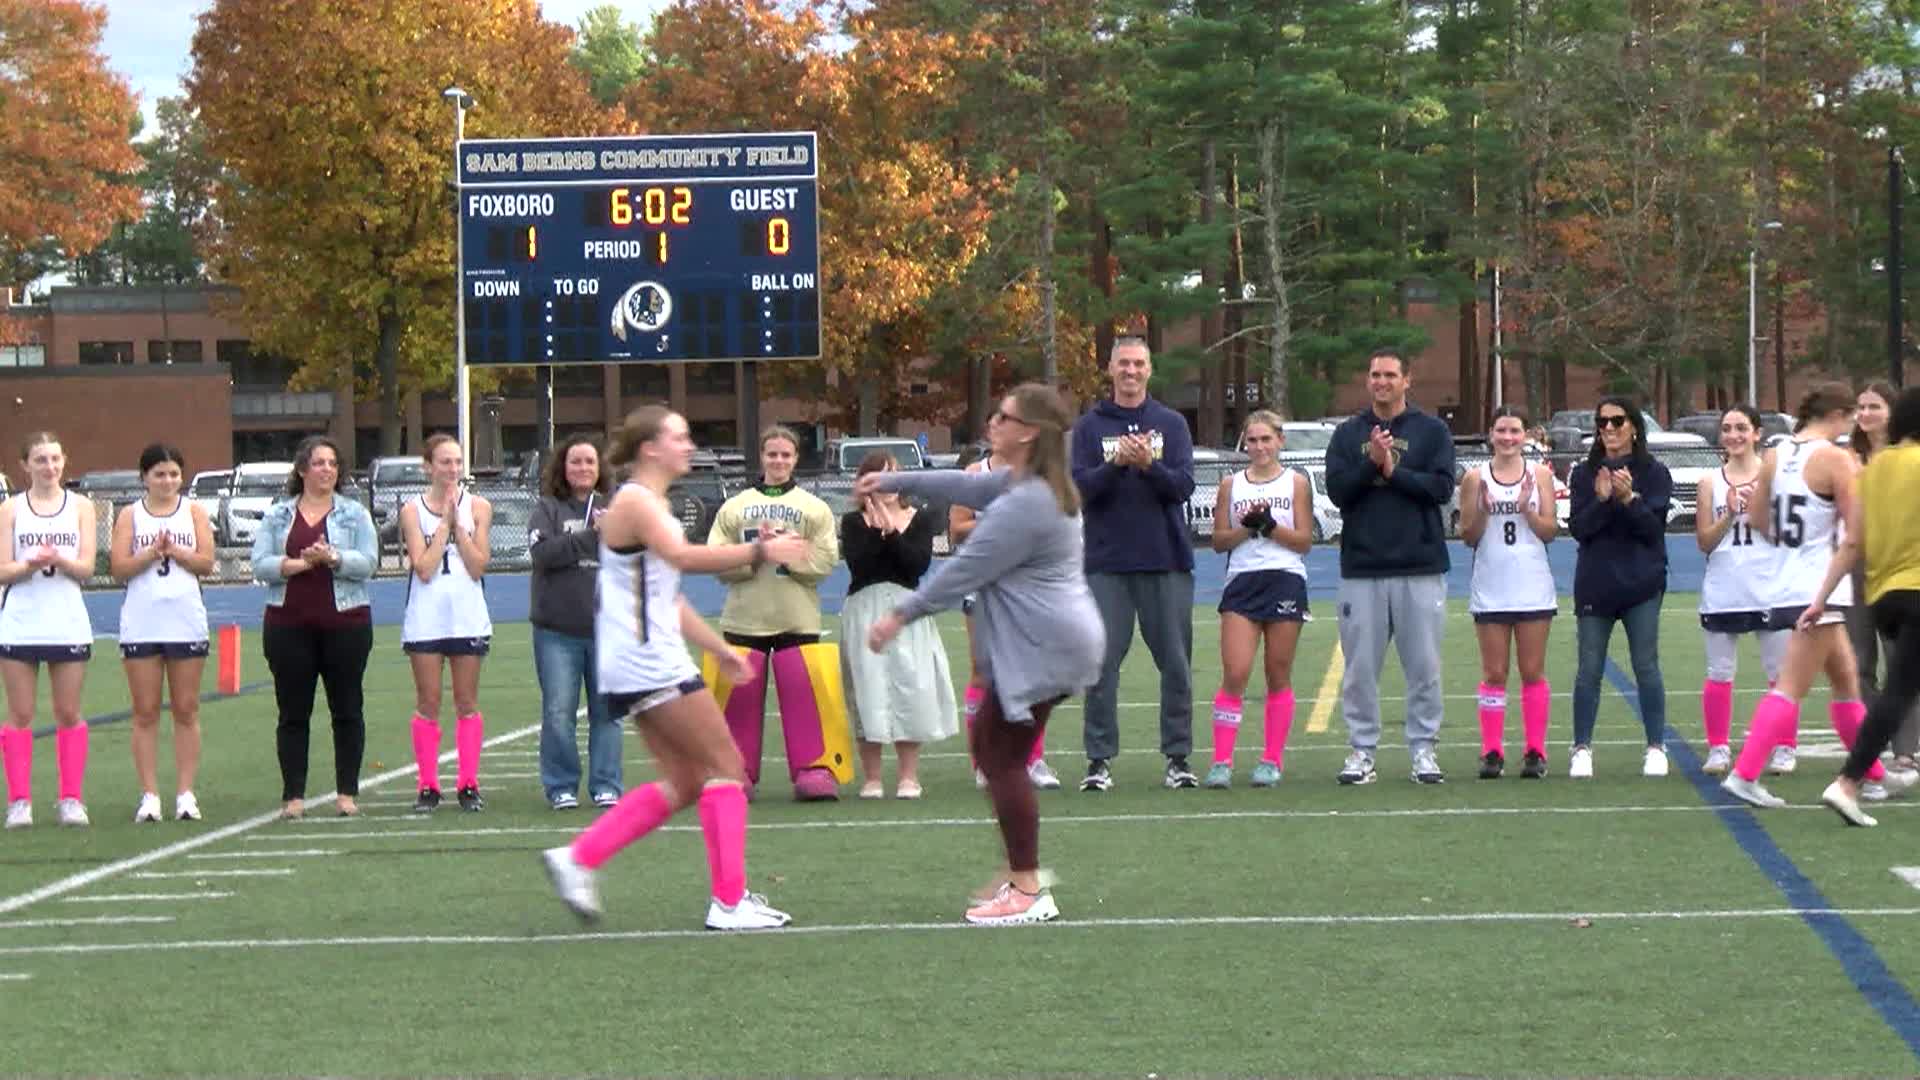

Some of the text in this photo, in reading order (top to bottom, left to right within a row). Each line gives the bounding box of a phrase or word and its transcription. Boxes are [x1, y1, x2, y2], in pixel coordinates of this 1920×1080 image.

[466, 145, 809, 172] SAM BERNS COMMUNITY FIELD
[469, 194, 554, 216] FOXBORO
[610, 187, 692, 224] 6:02
[730, 189, 798, 211] GUEST
[529, 225, 536, 258] 1
[659, 231, 667, 262] 1
[767, 218, 789, 254] 0
[584, 240, 641, 259] PERIOD
[474, 281, 519, 297] DOWN
[554, 278, 599, 295] TO GO
[752, 273, 814, 290] BALL ON
[1504, 521, 1516, 546] 8
[1732, 521, 1753, 546] 11
[1772, 494, 1808, 548] 15
[442, 551, 450, 575] 1
